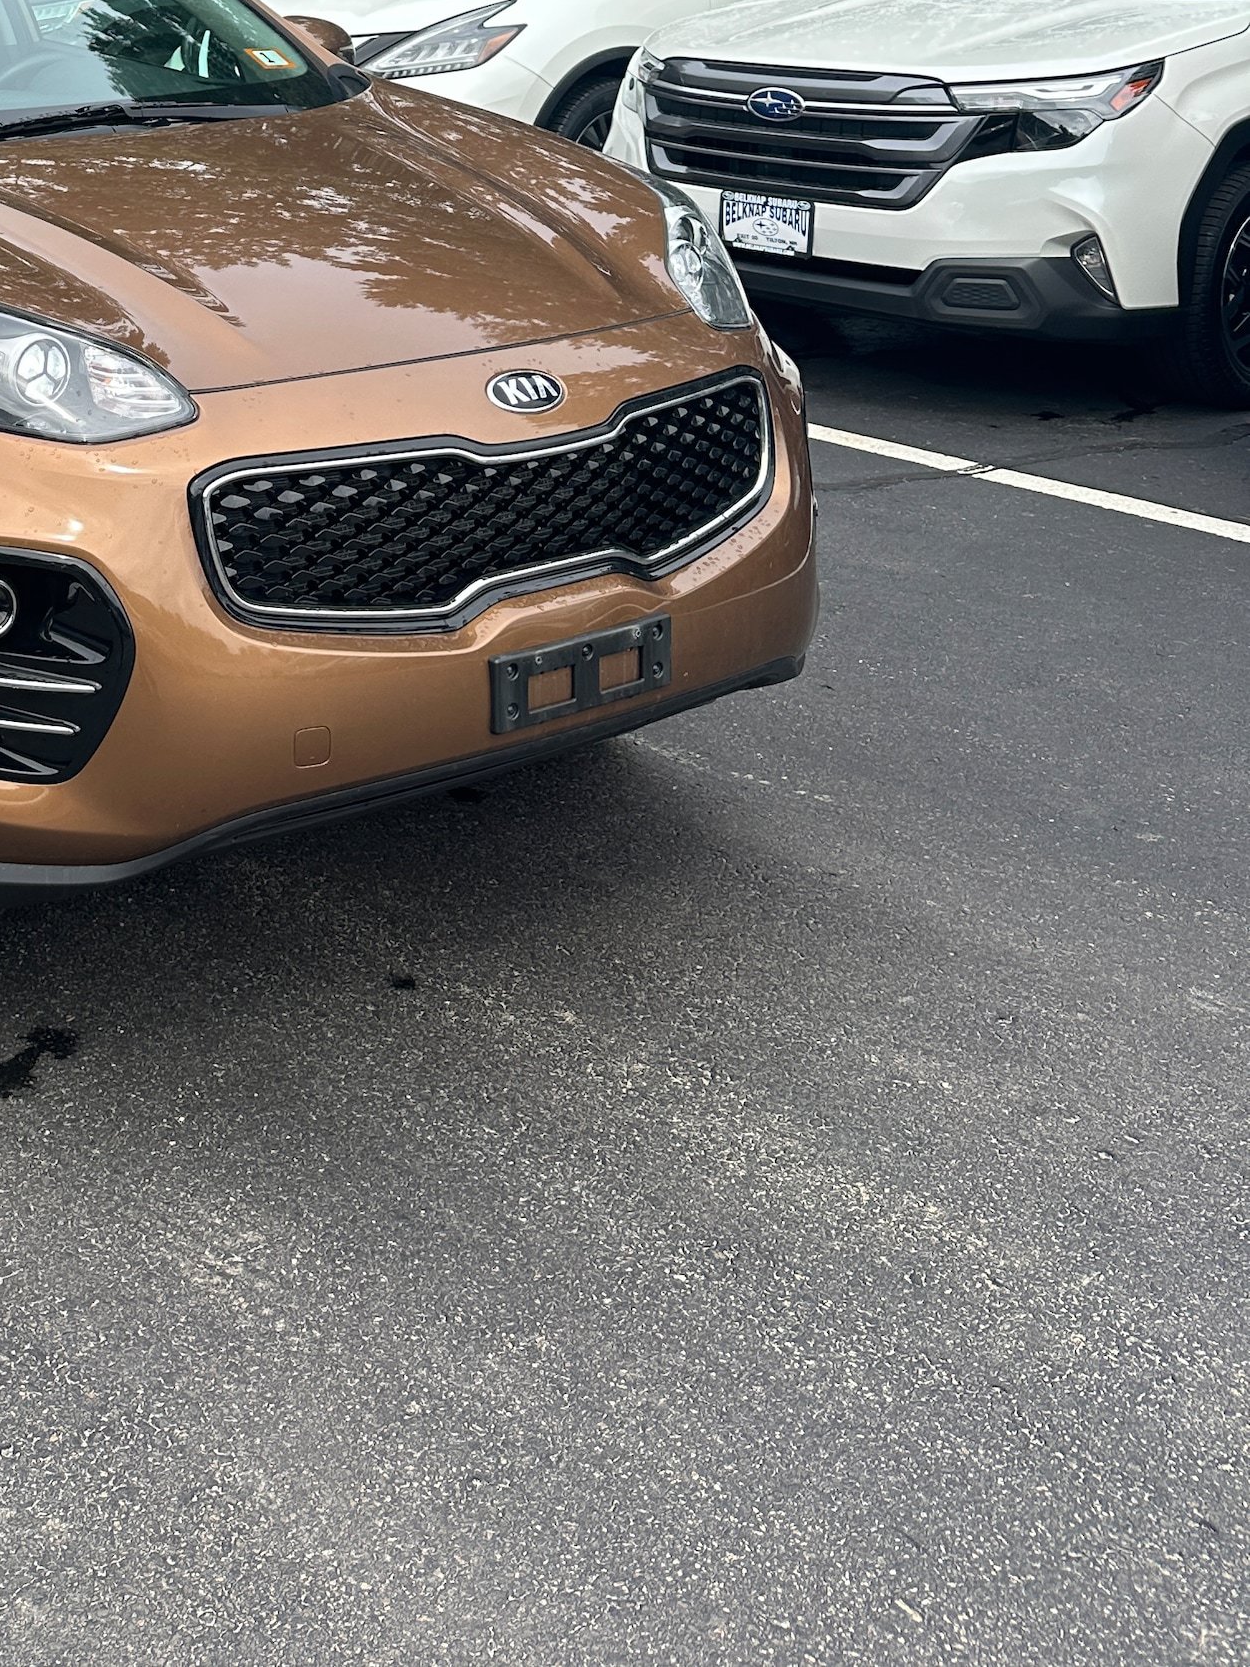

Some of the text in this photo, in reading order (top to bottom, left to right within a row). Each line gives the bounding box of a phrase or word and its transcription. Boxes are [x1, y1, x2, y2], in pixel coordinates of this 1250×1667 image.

[259, 52, 275, 63] 1
[734, 192, 798, 209] BELKNAP SUBARU
[726, 201, 807, 237] BELKNAP SUBARU
[496, 375, 558, 405] KIA
